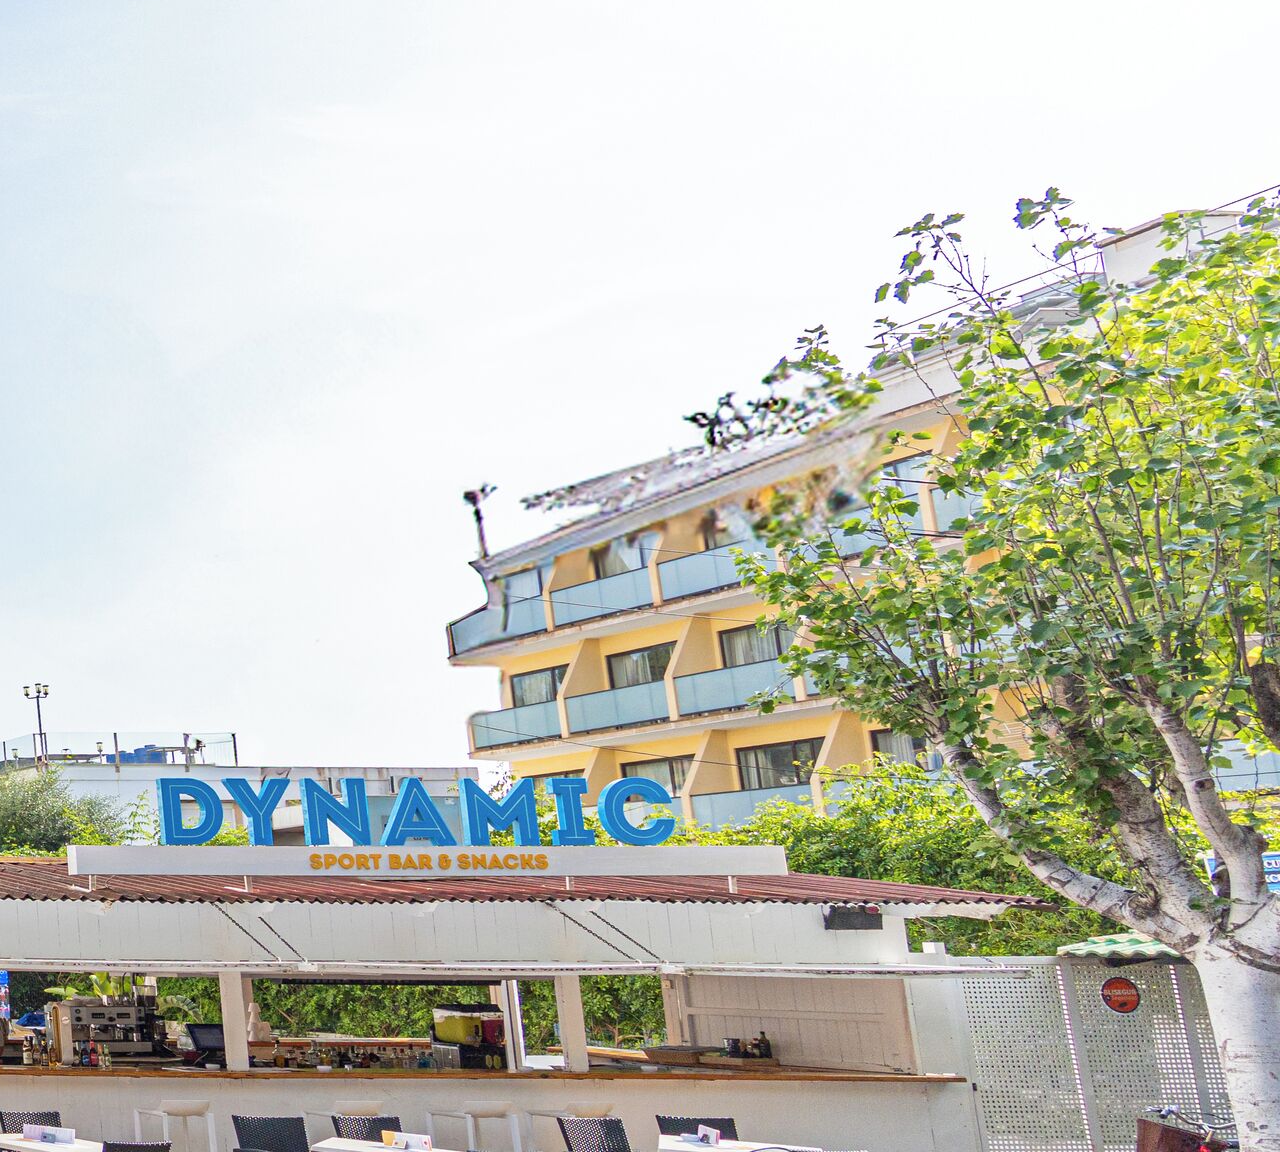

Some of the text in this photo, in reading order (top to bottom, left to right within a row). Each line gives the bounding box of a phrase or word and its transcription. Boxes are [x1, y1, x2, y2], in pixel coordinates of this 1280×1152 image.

[156, 776, 675, 847] DYNAMIC
[309, 853, 549, 870] SPORT BAR & SNACKS
